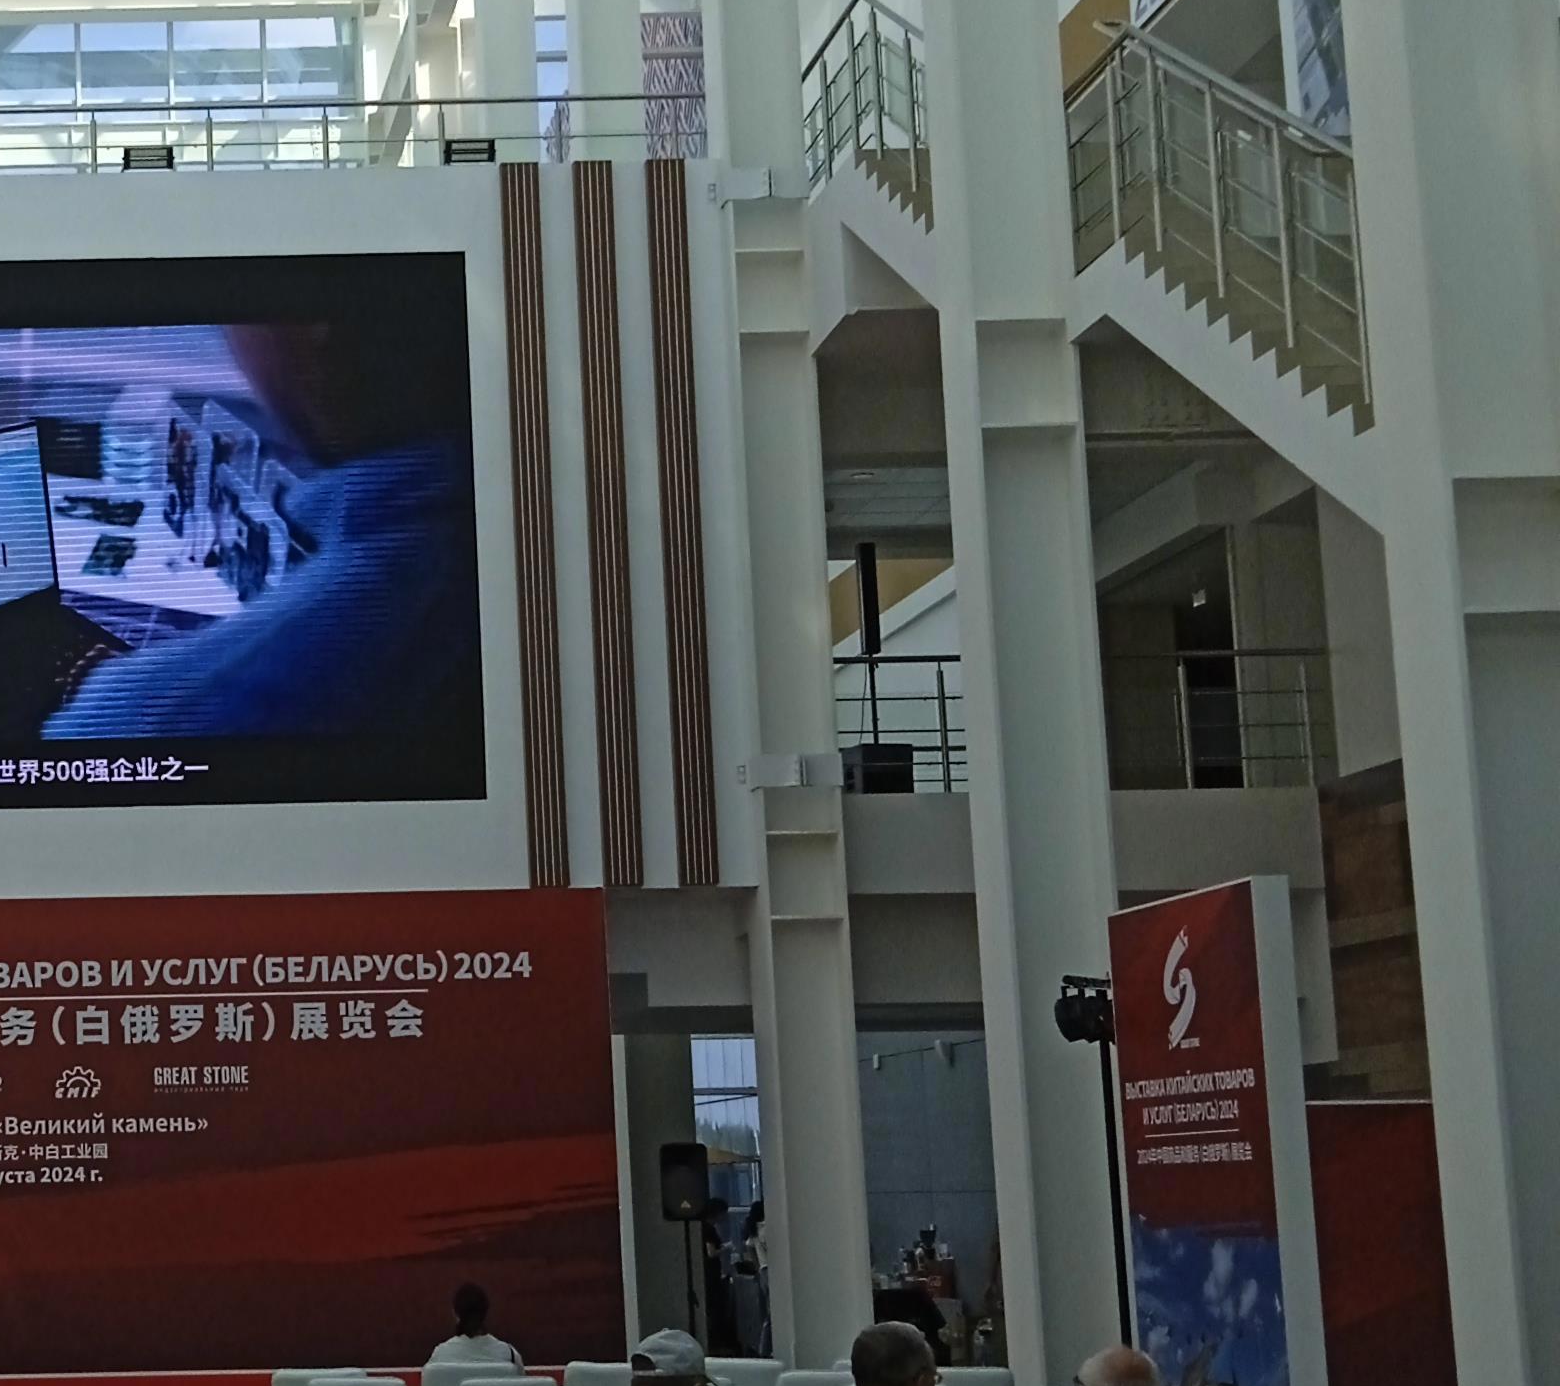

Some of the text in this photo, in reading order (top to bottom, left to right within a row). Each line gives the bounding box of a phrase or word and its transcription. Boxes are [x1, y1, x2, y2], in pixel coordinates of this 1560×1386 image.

[111, 959, 133, 986] И
[141, 957, 248, 986] УСЛУГ
[252, 950, 448, 986] (БЕЛАРУСЬ)
[453, 951, 533, 980] 2024
[153, 1065, 249, 1086] GREAT STONE
[1125, 1080, 1166, 1100] ВЫСТАВКА
[1215, 1068, 1255, 1090] ТОВАРОВ
[54, 1087, 101, 1099] CMIF
[112, 1115, 208, 1133] камень»
[40, 1166, 86, 1183] 2024
[90, 1169, 103, 1182] г.
